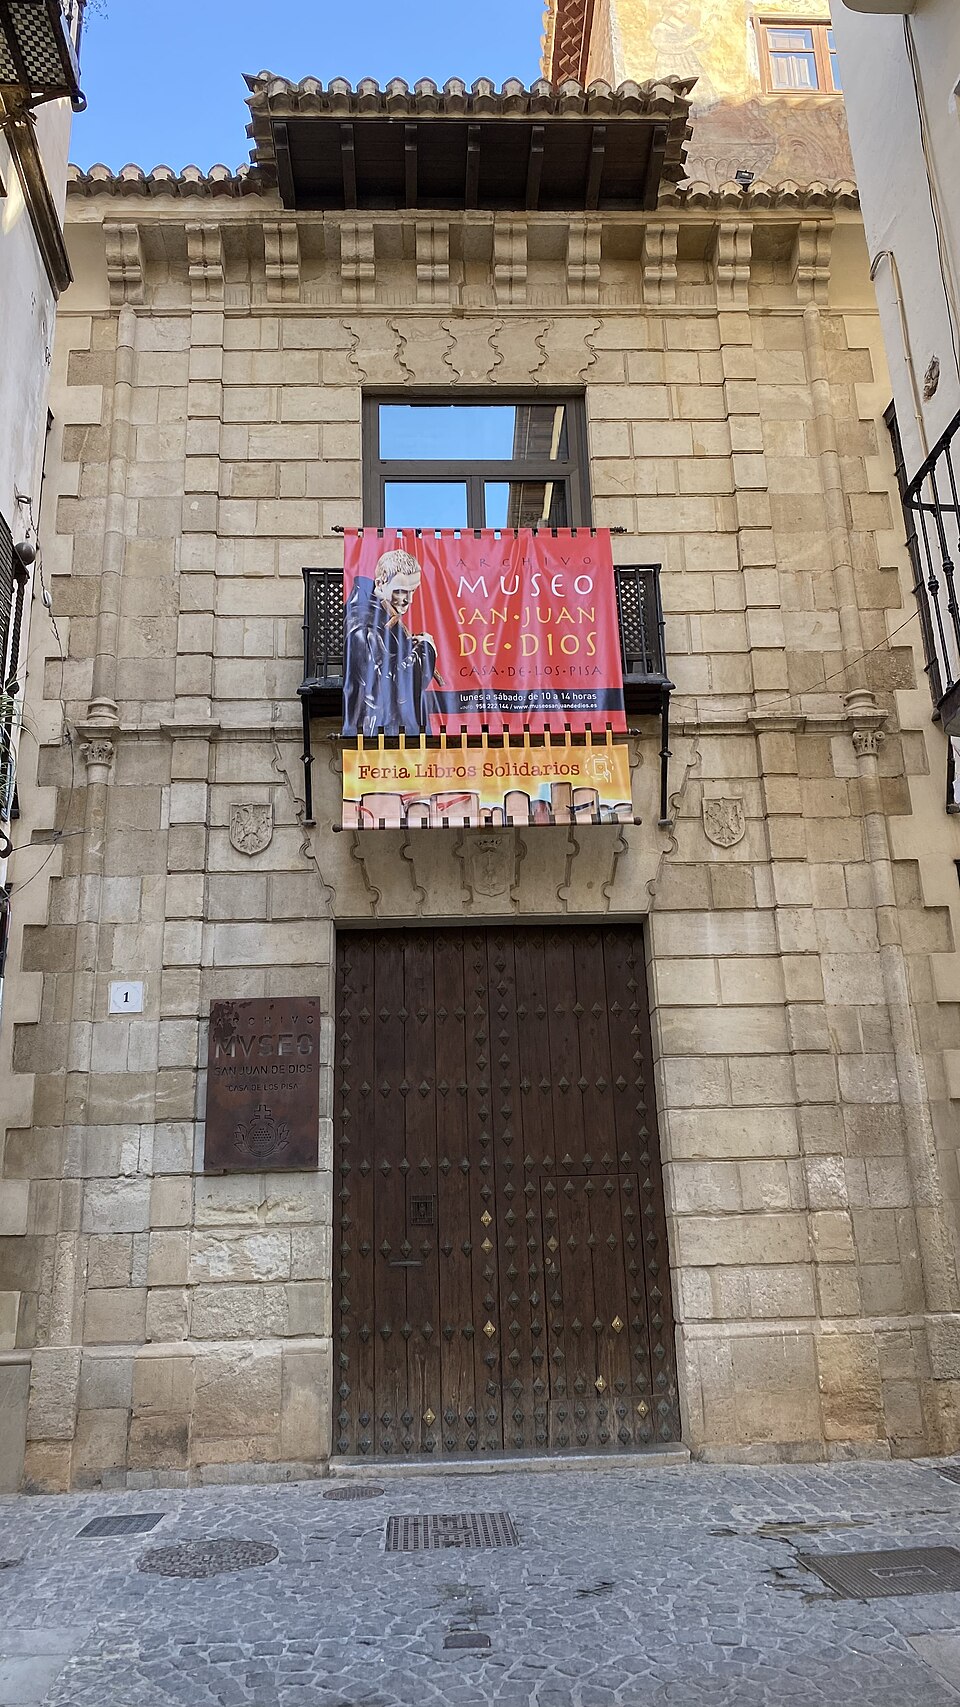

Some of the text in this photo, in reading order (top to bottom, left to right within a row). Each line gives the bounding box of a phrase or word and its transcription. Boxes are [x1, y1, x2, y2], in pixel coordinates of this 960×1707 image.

[456, 556, 592, 567] ARCHIVO
[456, 573, 593, 598] MUSEO
[460, 693, 484, 702] lunes
[493, 692, 526, 702] sábado:
[528, 692, 539, 701] de
[541, 692, 551, 700] 10
[561, 692, 571, 700] 14
[572, 692, 597, 700] horas
[357, 761, 580, 780] Feria Libros Solidarios
[123, 991, 130, 1003] 1
[215, 1063, 313, 1076] SAN JUAN DE DIOS
[228, 1082, 299, 1092] CASA DE LOS PISA
